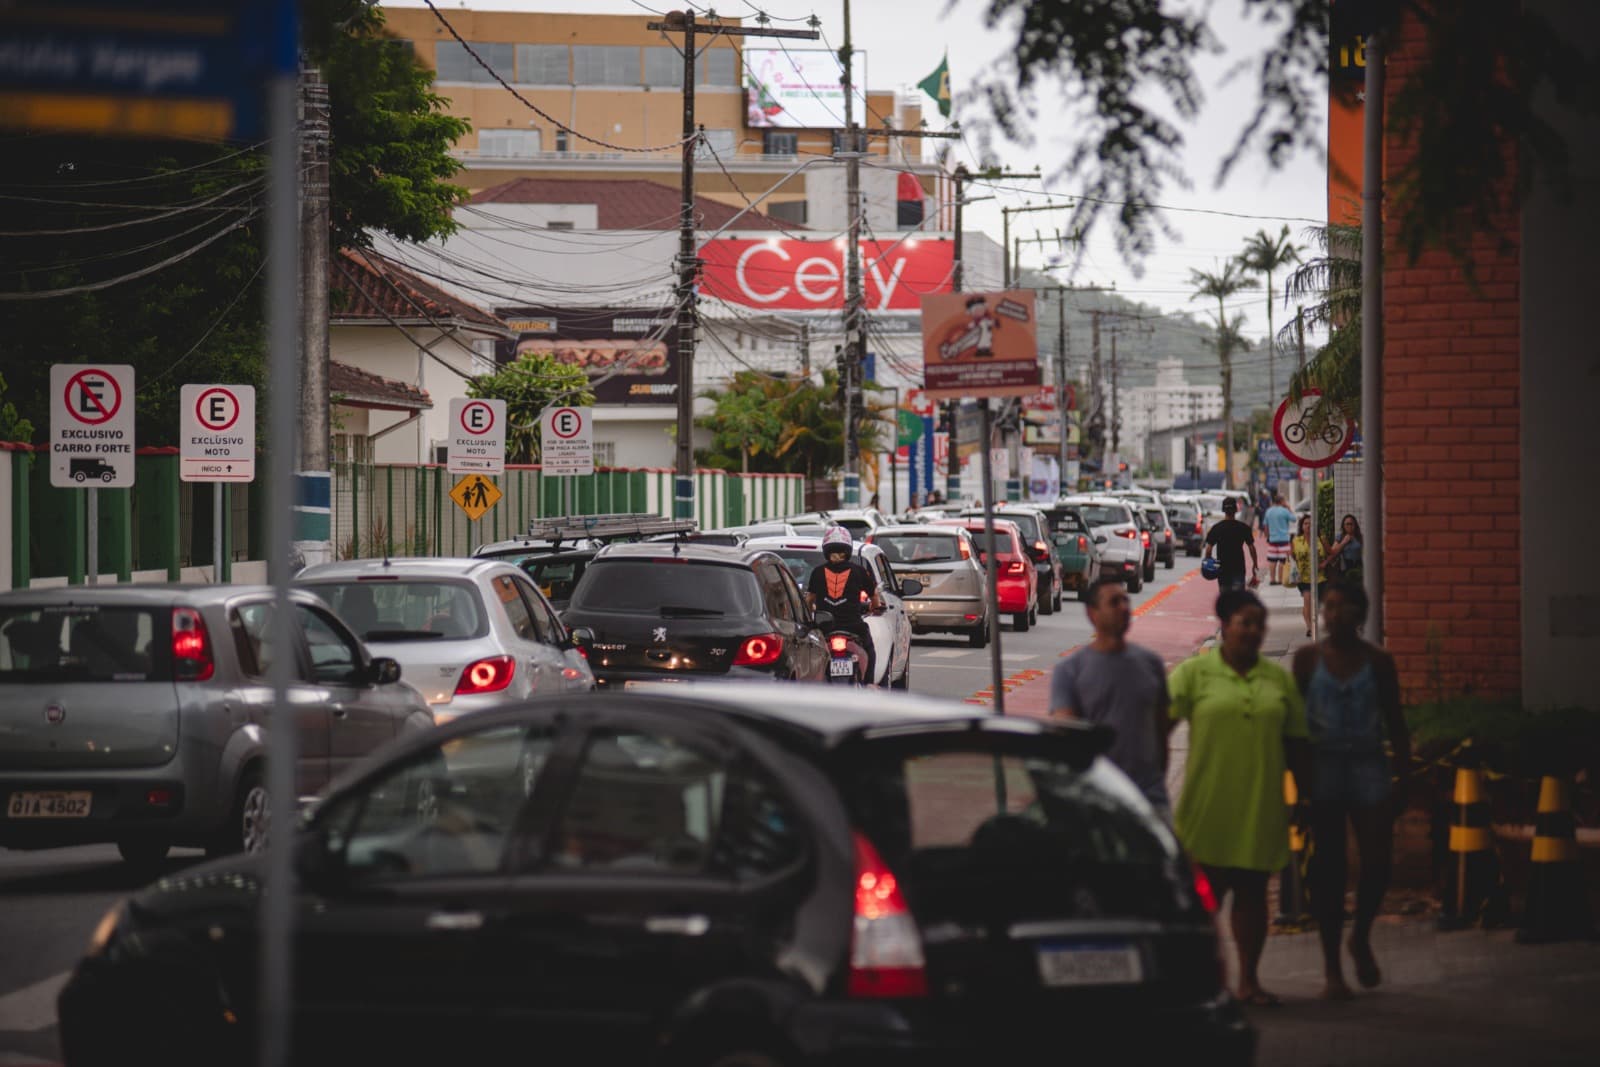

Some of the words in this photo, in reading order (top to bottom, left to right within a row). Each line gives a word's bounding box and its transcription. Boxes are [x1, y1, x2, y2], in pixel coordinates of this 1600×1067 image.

[629, 384, 677, 395] SUBWAY
[80, 381, 105, 412] E
[210, 397, 225, 421] E
[471, 408, 484, 428] E
[561, 415, 572, 432] E
[61, 430, 124, 439] EXCLUSIVO
[191, 437, 244, 445] EXCLUSIVO
[456, 439, 497, 447] EXCLUSIVO
[54, 443, 92, 453] CARRO
[95, 444, 131, 453] FORTE
[204, 448, 230, 456] MOTO
[592, 643, 627, 651] PEUGEOT
